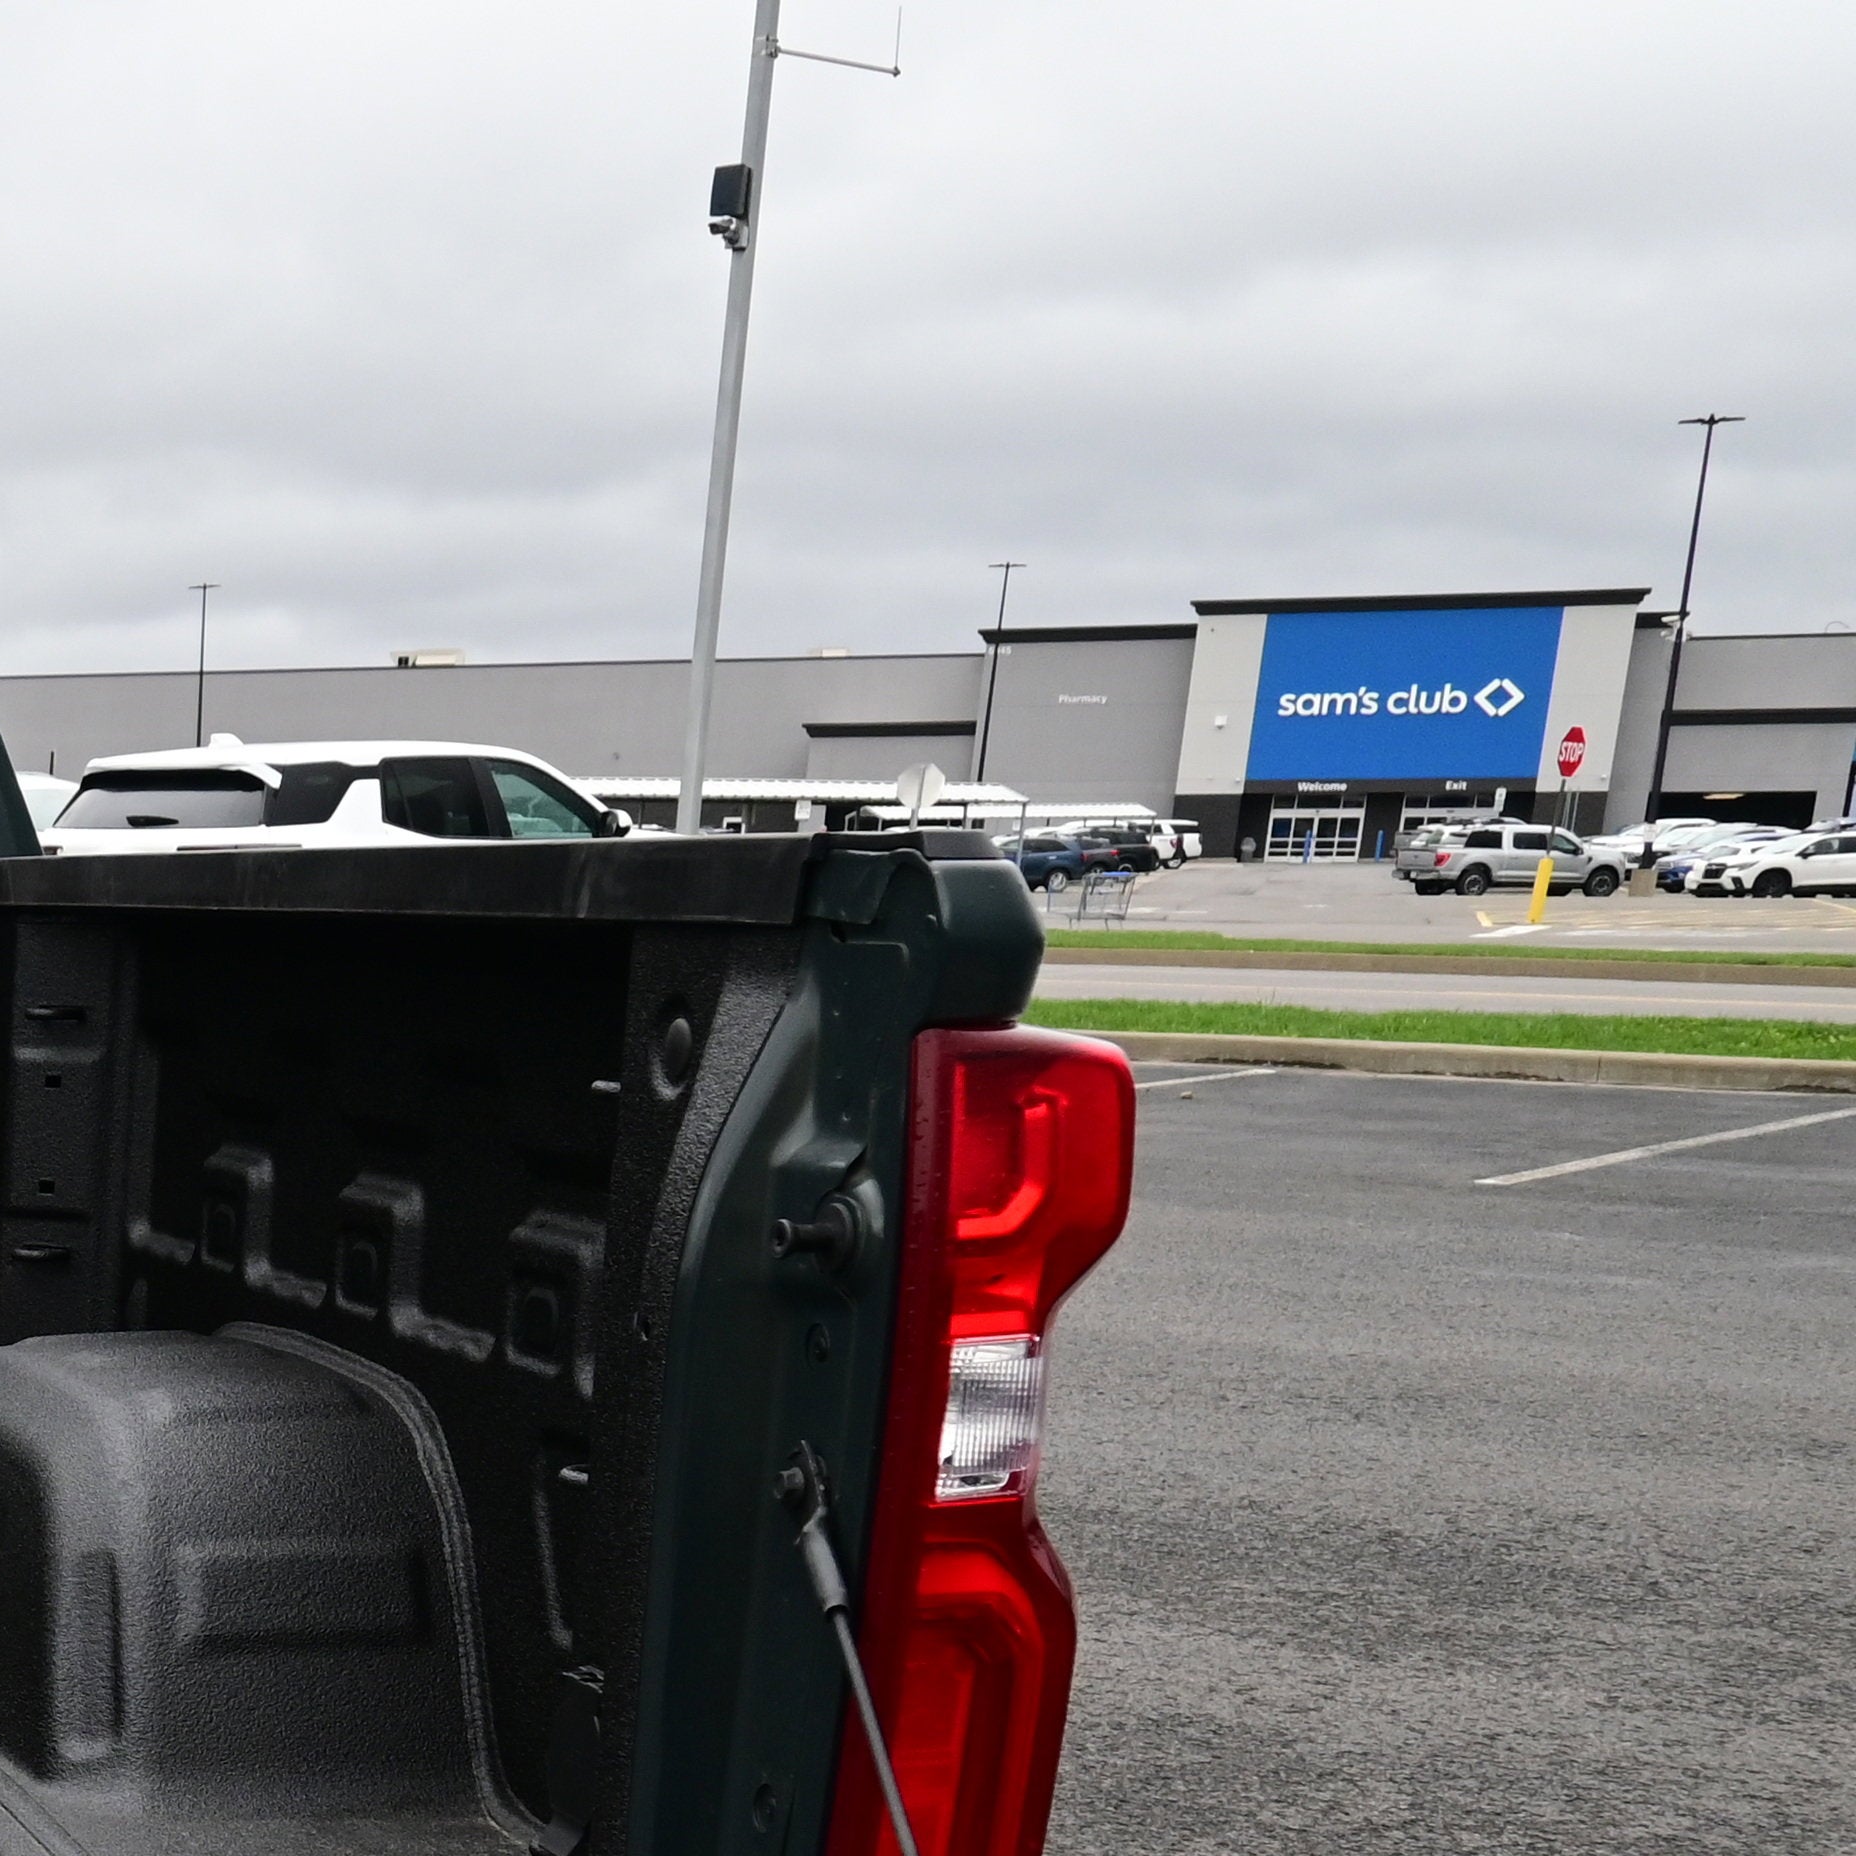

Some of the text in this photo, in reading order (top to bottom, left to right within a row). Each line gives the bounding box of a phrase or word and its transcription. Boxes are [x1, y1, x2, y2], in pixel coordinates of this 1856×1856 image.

[988, 646, 1012, 655] 645
[1058, 694, 1108, 705] Pharmacy
[1278, 683, 1468, 716] sam's club
[1559, 742, 1584, 763] STOP
[1297, 781, 1348, 792] Welcome
[1445, 780, 1467, 791] Exit
